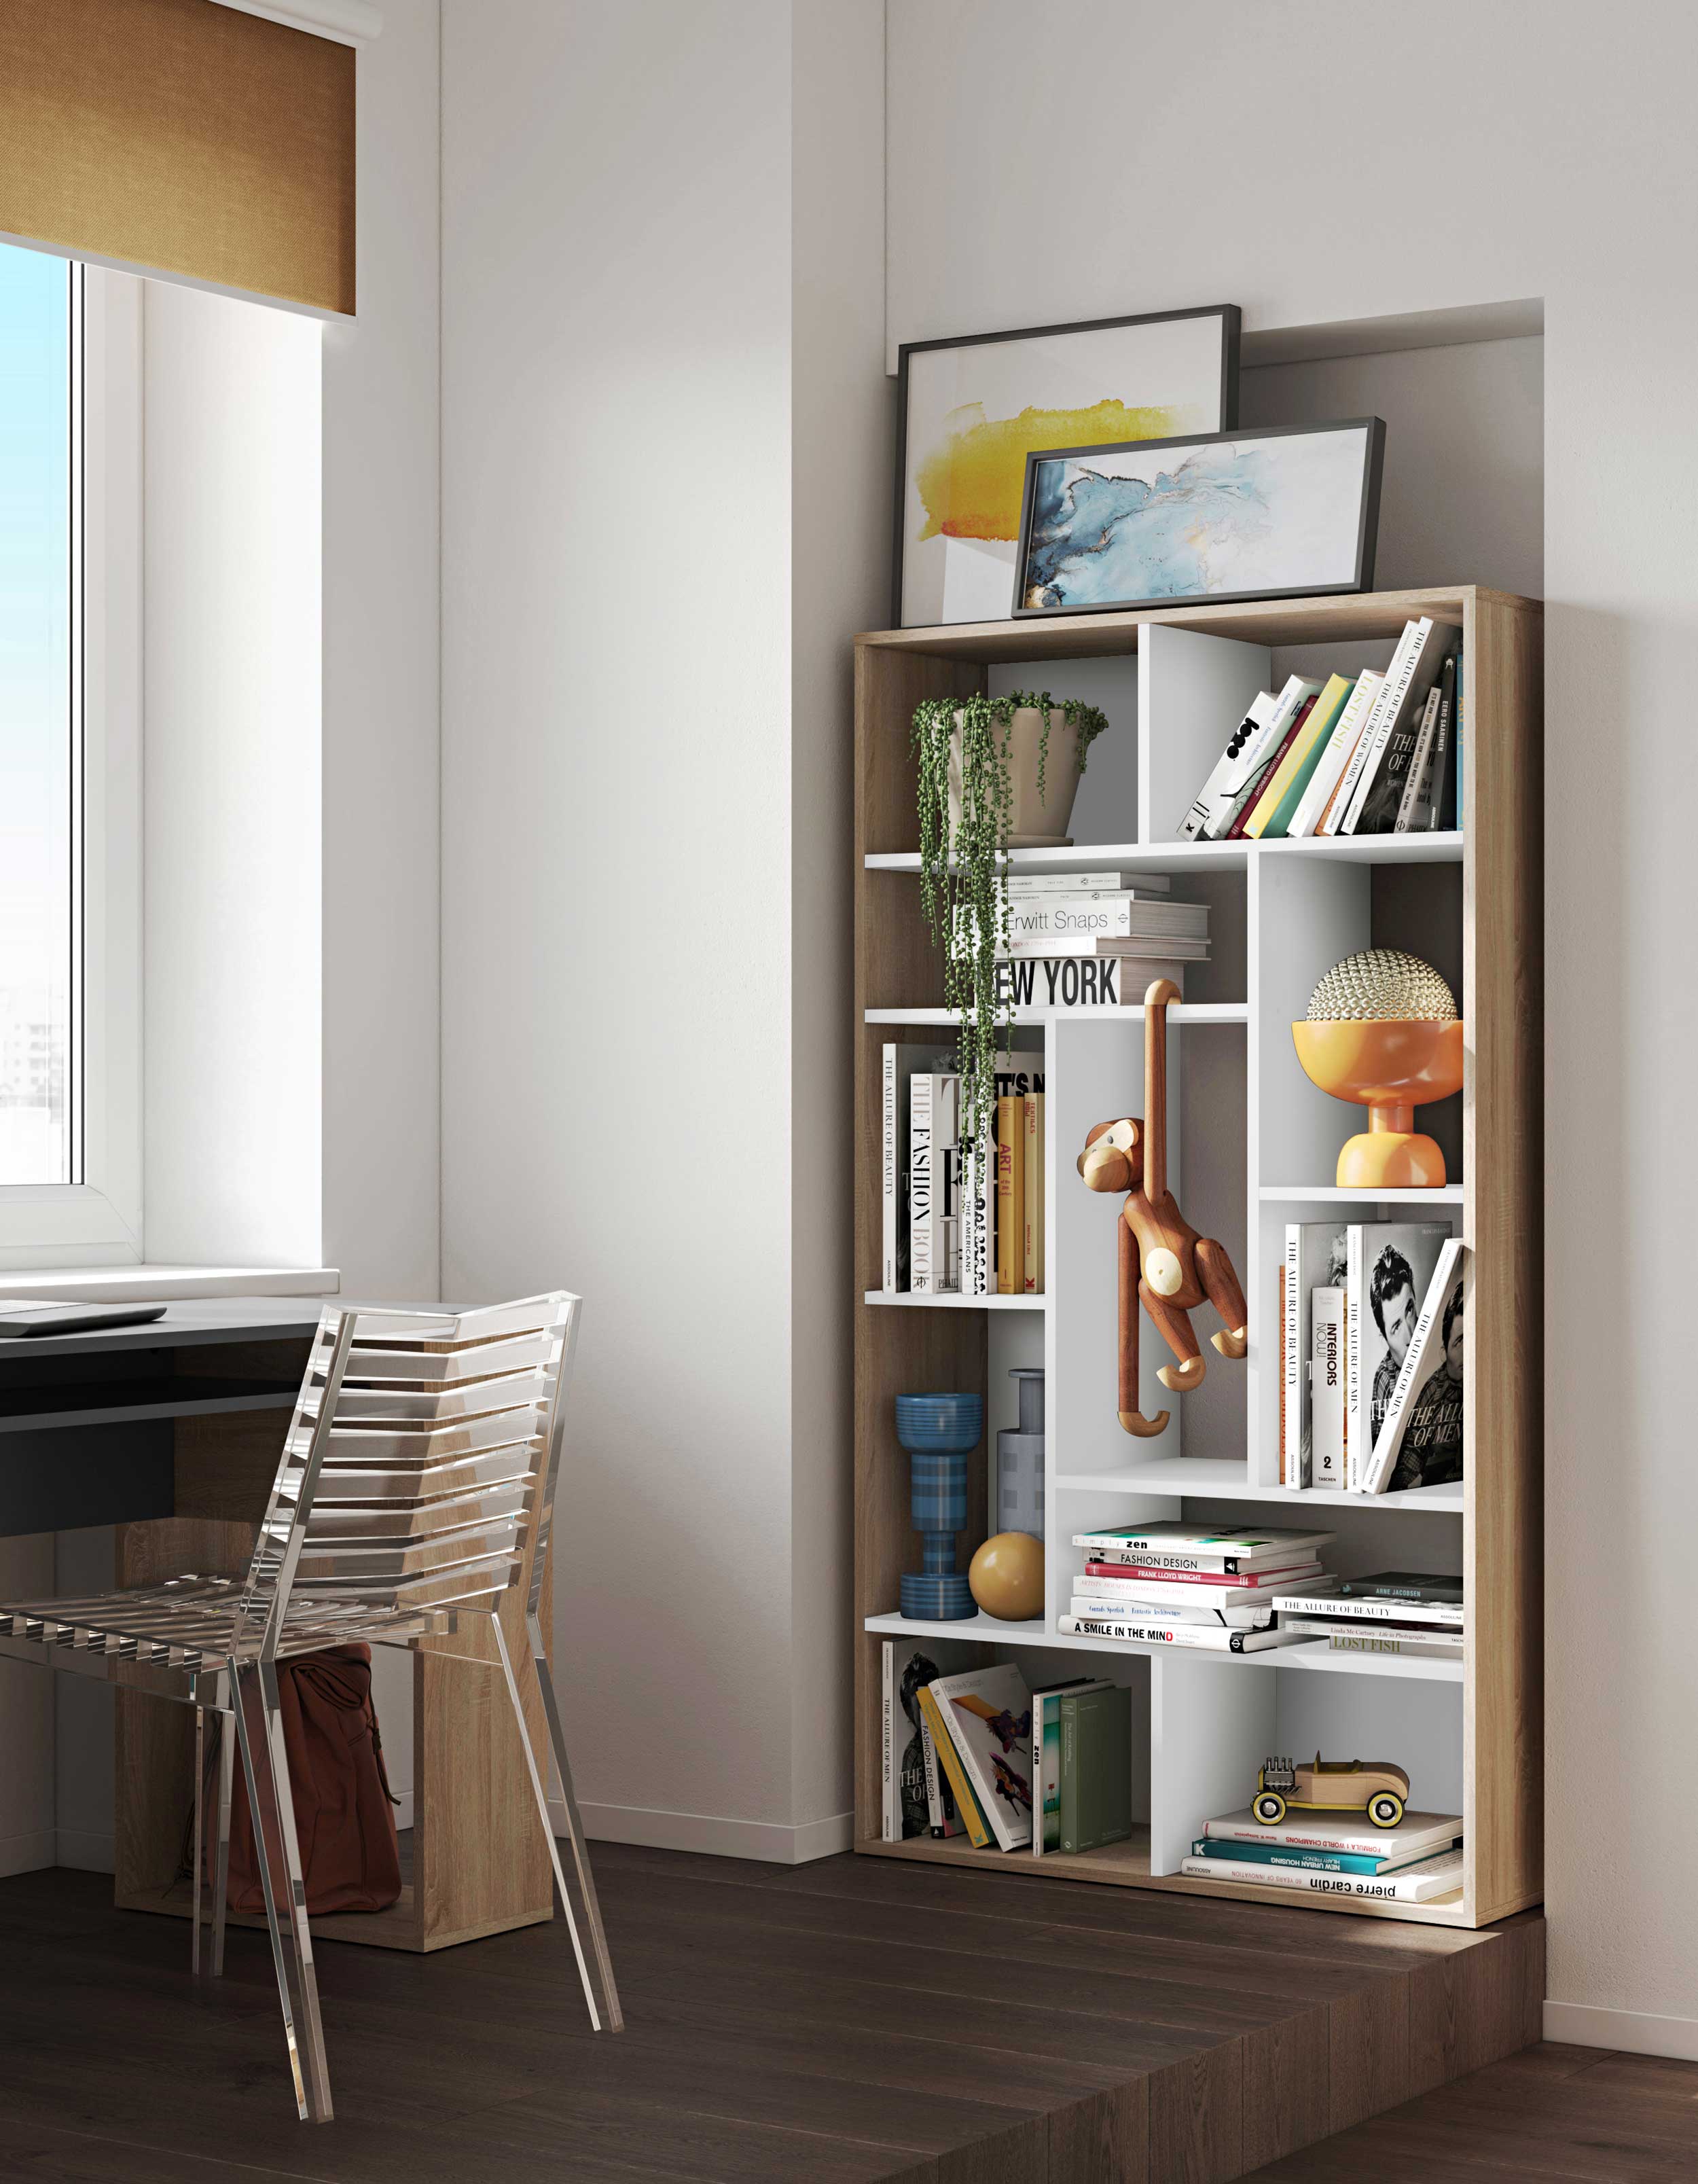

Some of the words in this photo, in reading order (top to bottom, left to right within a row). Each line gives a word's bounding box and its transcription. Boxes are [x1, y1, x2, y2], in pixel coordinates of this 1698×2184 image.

[1413, 631, 1426, 654] THE
[1396, 653, 1416, 694] ALLURE
[1379, 683, 1392, 702] THE
[1391, 694, 1402, 709] OF
[1364, 703, 1384, 738] ALLURE
[1375, 709, 1396, 751] BEAUTY
[1438, 719, 1448, 752] SAARINEN
[1277, 742, 1288, 759] FRANK
[1360, 738, 1369, 751] OF
[1267, 758, 1278, 776] LLOYD
[1345, 751, 1365, 787] WOMEN
[1388, 753, 1406, 771] OF
[1254, 775, 1269, 797] WRIGHT
[1007, 910, 1049, 930] Erwitt
[1055, 910, 1108, 932] Snaps
[993, 960, 1036, 1006] EW
[1043, 959, 1118, 1006] YORK
[885, 1058, 893, 1081] THE
[885, 1087, 893, 1129] ALLURE
[913, 1076, 931, 1122] THE
[885, 1132, 893, 1147] OF
[1000, 1143, 1011, 1175] ART
[885, 1149, 893, 1196] BEAUTY
[913, 1128, 931, 1222] FASHION
[939, 1278, 958, 1289] PHAID
[1288, 1318, 1297, 1335] OF
[1420, 1314, 1431, 1334] THE
[1288, 1338, 1297, 1386] BEAUTY
[1327, 1323, 1337, 1386] INTERIORS
[1405, 1336, 1422, 1379] ALLURE
[1351, 1372, 1358, 1386] OF
[1399, 1378, 1409, 1391] OF
[1371, 1399, 1391, 1421] TH
[1390, 1393, 1404, 1418] MEN
[1407, 1406, 1435, 1428] THE
[1434, 1402, 1464, 1424] ALLU
[1413, 1426, 1434, 1447] OF
[1432, 1423, 1464, 1444] MEN
[1324, 1456, 1331, 1469] 2
[1126, 1541, 1148, 1550] zen
[1121, 1554, 1160, 1566] FASHION
[1163, 1558, 1198, 1569] DESIGN
[1158, 1571, 1177, 1579] LLOYD
[1177, 1573, 1202, 1581] WRIGHT
[1376, 1588, 1391, 1596] ARNE
[1392, 1589, 1421, 1597] JACOBSEN
[1284, 1600, 1303, 1610] THE
[1303, 1603, 1339, 1613] ALLURE
[1339, 1605, 1352, 1613] OF
[1354, 1607, 1391, 1616] BEAUTY
[1074, 1622, 1081, 1632] A
[1084, 1623, 1112, 1636] SMILE
[1115, 1626, 1125, 1636] IN
[1127, 1628, 1144, 1639] THE
[1148, 1630, 1174, 1642] MIND
[1334, 1636, 1368, 1649] LOST
[1371, 1639, 1401, 1653] FISH
[922, 1725, 931, 1764] FASHION
[884, 1751, 890, 1763] OF
[899, 1767, 923, 1788] THE
[926, 1768, 935, 1800] DESIGN
[1286, 1836, 1322, 1846] CHAMPIONS
[1322, 1841, 1345, 1849] WORLD
[1351, 1844, 1381, 1853] FORMULA
[1187, 1865, 1211, 1874] ASSOULINE
[1271, 1857, 1301, 1866] HOUSING
[1301, 1861, 1324, 1869] URBAN
[1231, 1871, 1265, 1880] INNOVATION
[1276, 1876, 1293, 1884] YEARS
[1310, 1878, 1352, 1892] cardin
[1356, 1884, 1396, 1899] pierre
